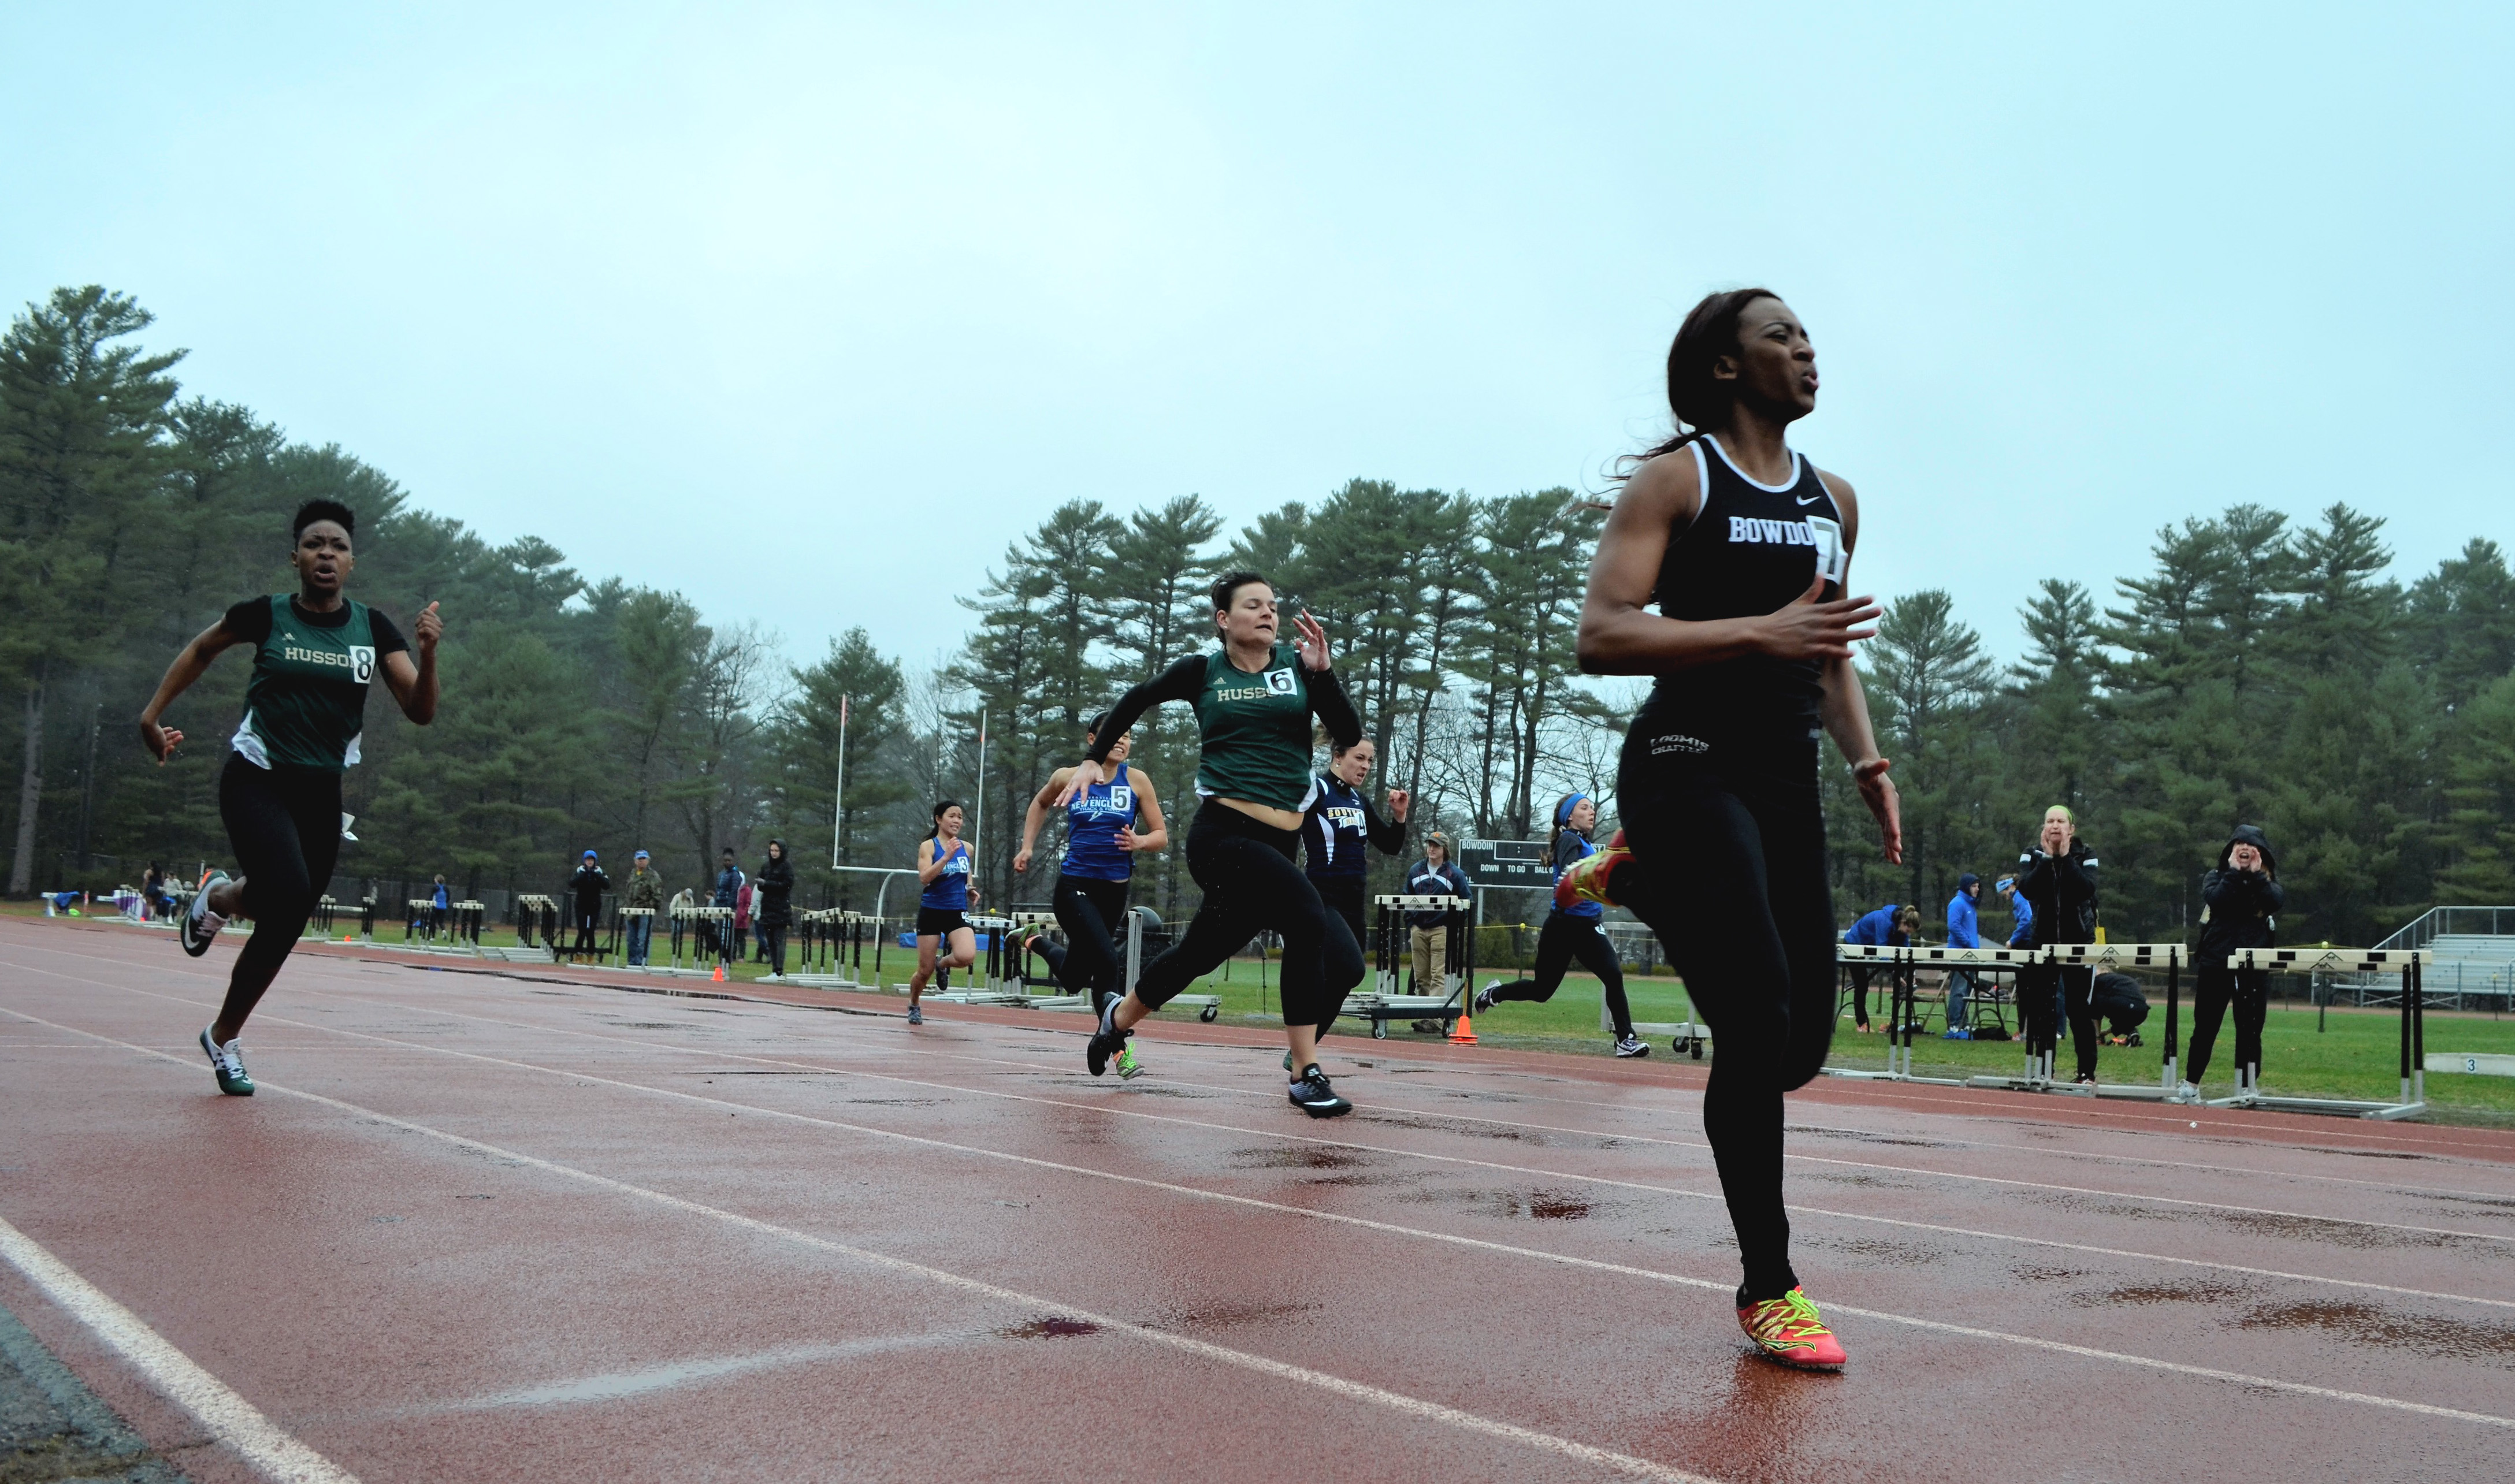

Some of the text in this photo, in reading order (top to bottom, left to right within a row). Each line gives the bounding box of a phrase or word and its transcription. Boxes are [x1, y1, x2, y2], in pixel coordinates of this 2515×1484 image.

[1814, 521, 1836, 575] 7
[356, 648, 372, 680] 8
[1270, 671, 1292, 692] 6
[1114, 788, 1127, 809] 5
[1358, 813, 1366, 833] 4
[1462, 841, 1494, 850] BOWDOIN
[960, 858, 968, 871] 3
[1517, 865, 1525, 873] GO
[2468, 1059, 2475, 1071] 3
